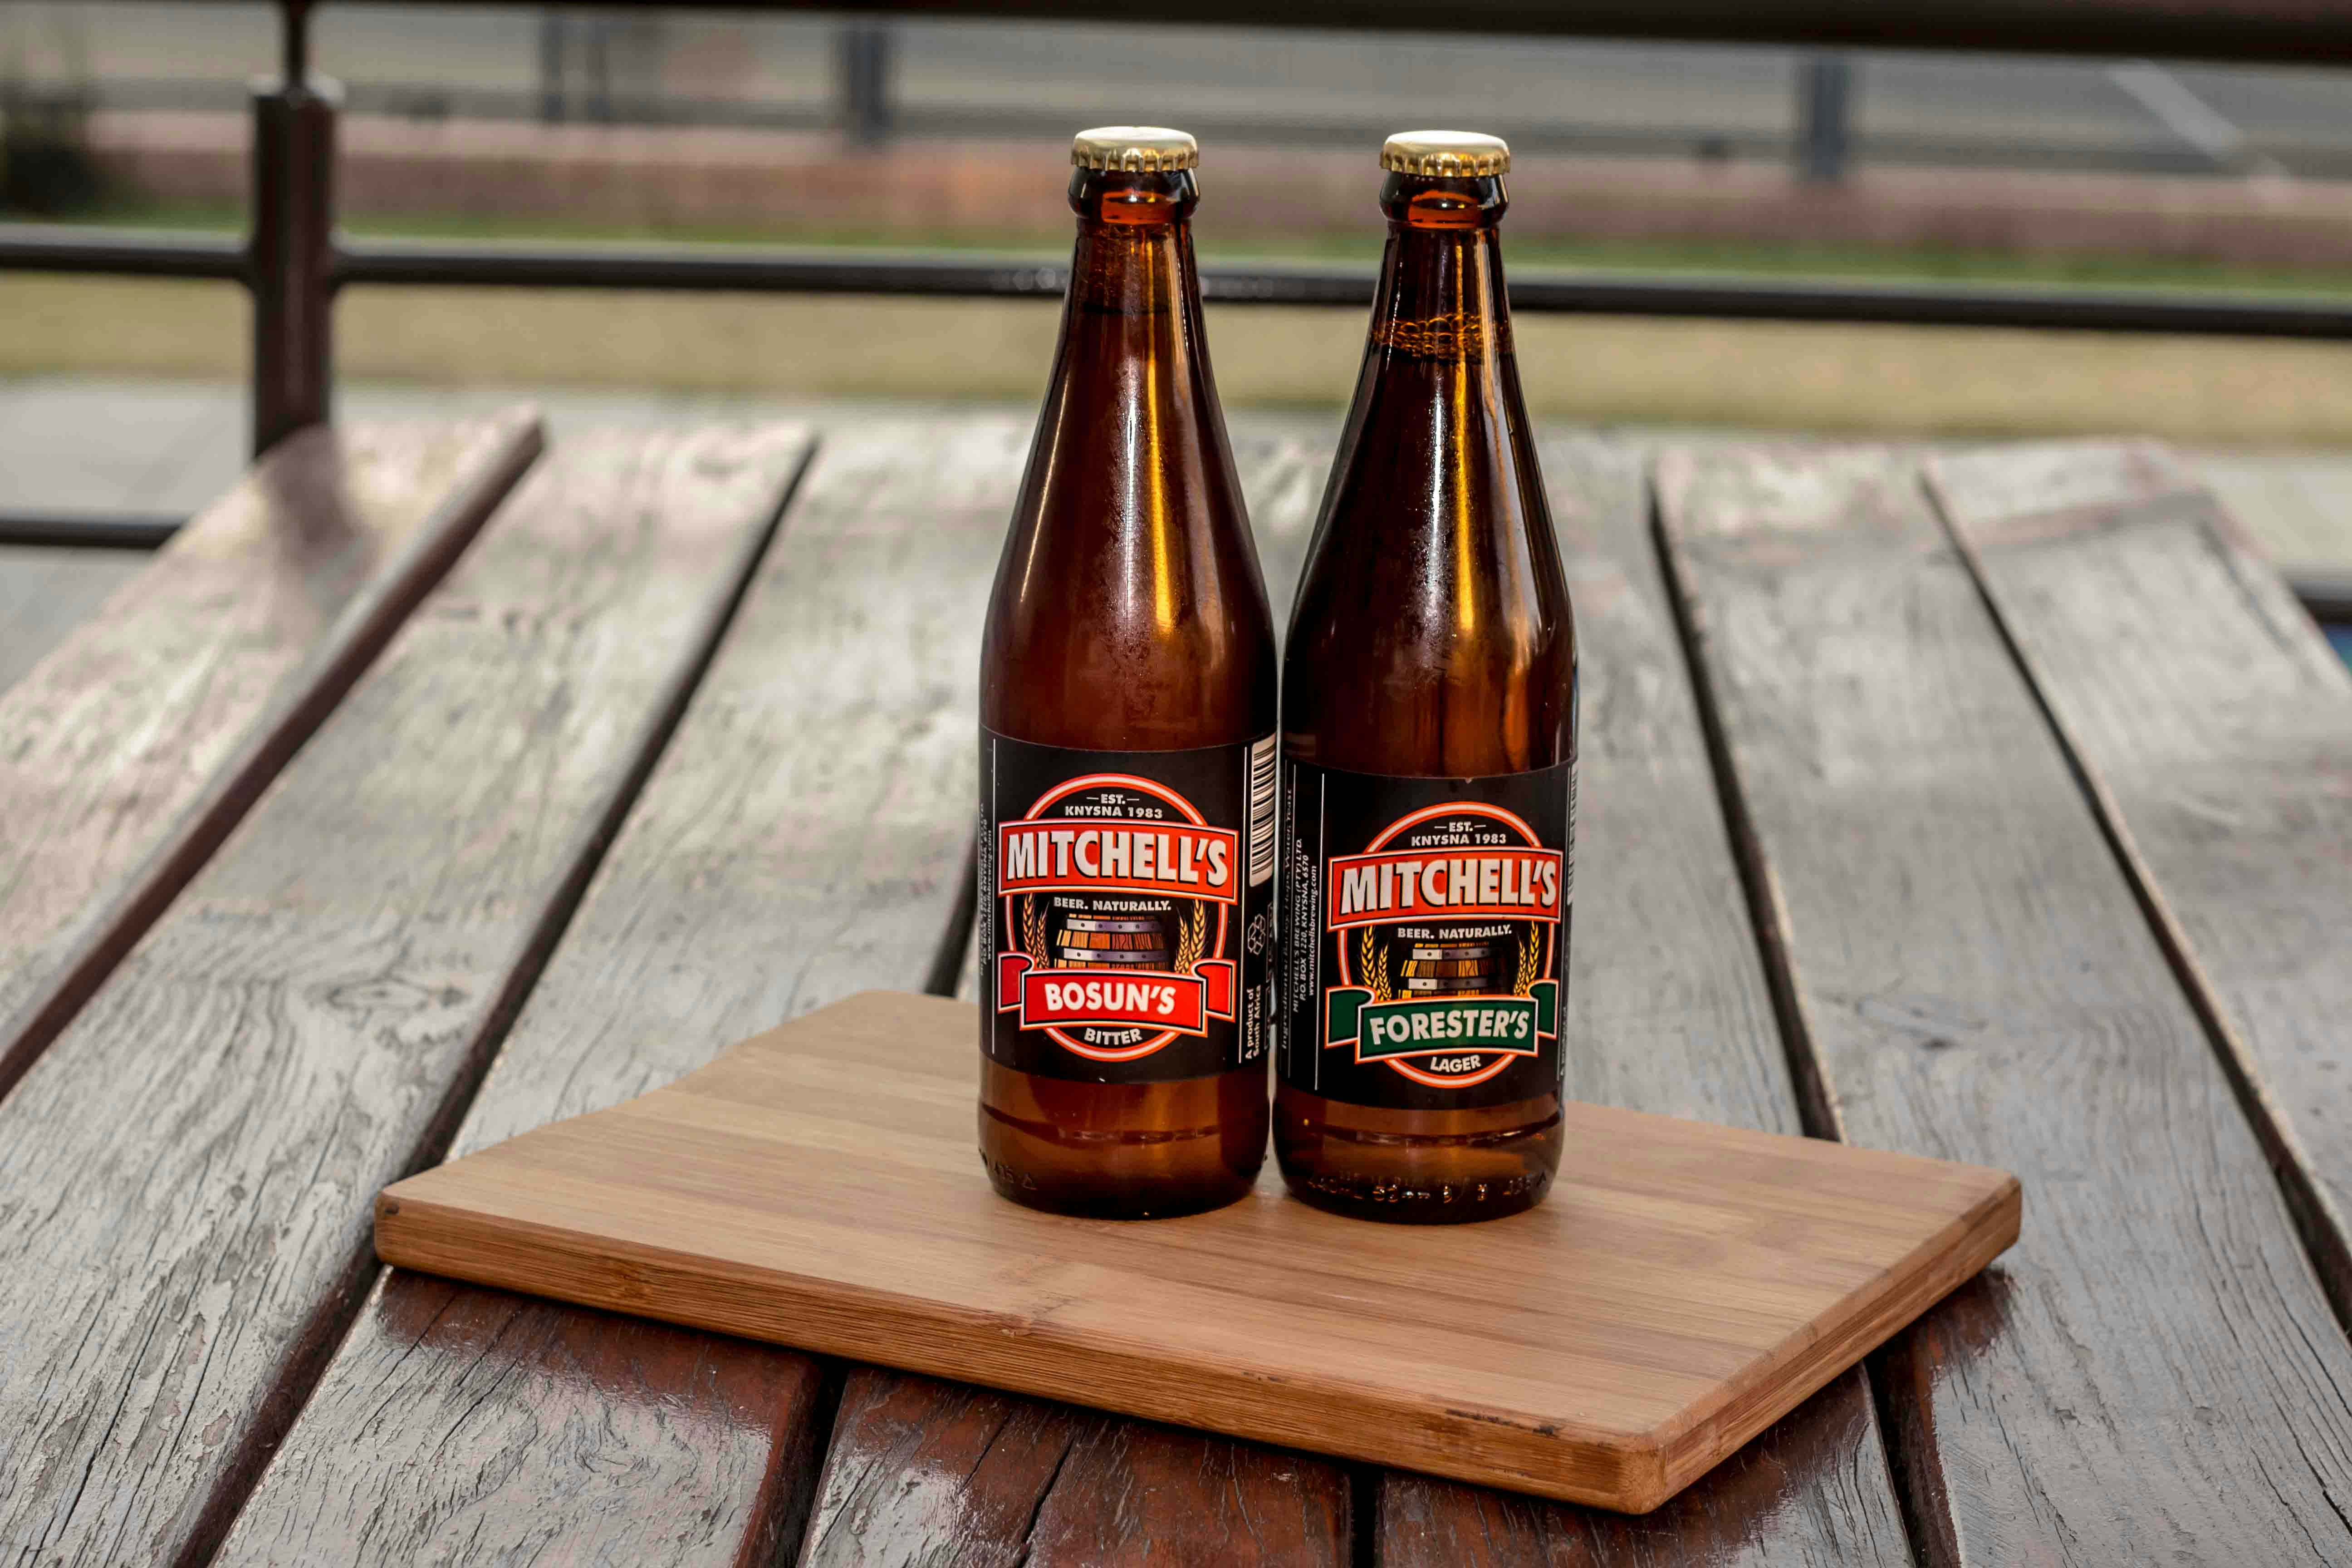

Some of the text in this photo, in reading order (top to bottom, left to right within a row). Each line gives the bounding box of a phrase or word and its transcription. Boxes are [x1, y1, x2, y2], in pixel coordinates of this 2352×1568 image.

[1101, 794, 1126, 804] EST.
[1065, 806, 1163, 818] KNYSNA 1983
[1449, 822, 1473, 832] EST.
[1411, 834, 1507, 847] KNYSNA 1983
[1007, 830, 1228, 887] MITCHELL'S
[1340, 858, 1557, 915] MITCHELL'S
[1054, 897, 1171, 911] BEER. NATURALLY.
[1308, 865, 1318, 996] www.mitchellsbrewing.com
[1397, 924, 1512, 939] BEER. NATURALLY.
[1044, 981, 1176, 1015] BOSUN'S
[1245, 988, 1254, 1059] A product of
[1369, 1009, 1530, 1045] FORESTER'S
[1084, 1027, 1143, 1045] BITTER
[1430, 1055, 1481, 1073] LAGER
